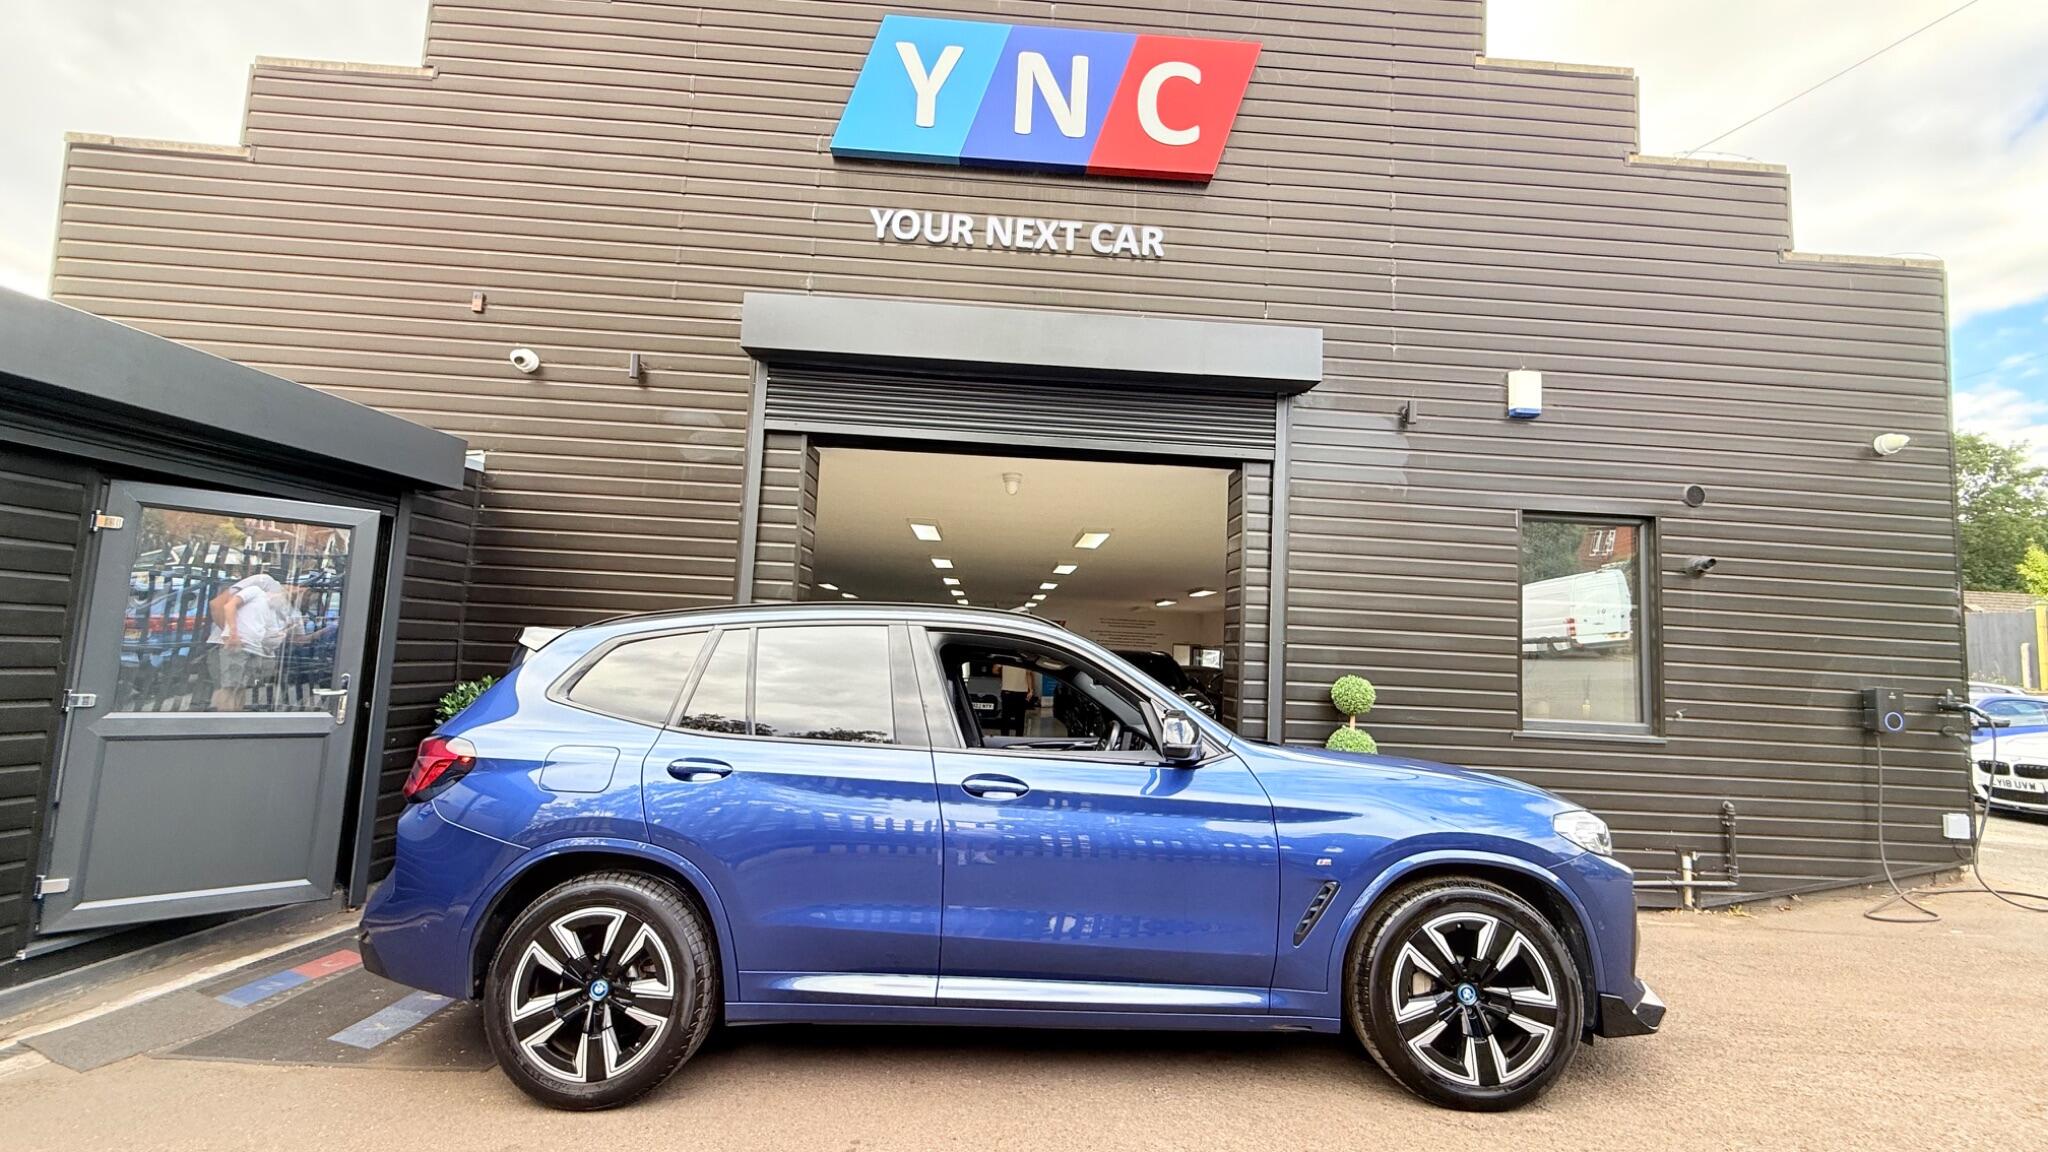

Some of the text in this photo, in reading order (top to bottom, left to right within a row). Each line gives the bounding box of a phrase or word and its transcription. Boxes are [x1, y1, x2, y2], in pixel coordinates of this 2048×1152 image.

[896, 41, 1201, 145] YNC
[869, 208, 1165, 256] YOUR NEXT CAR
